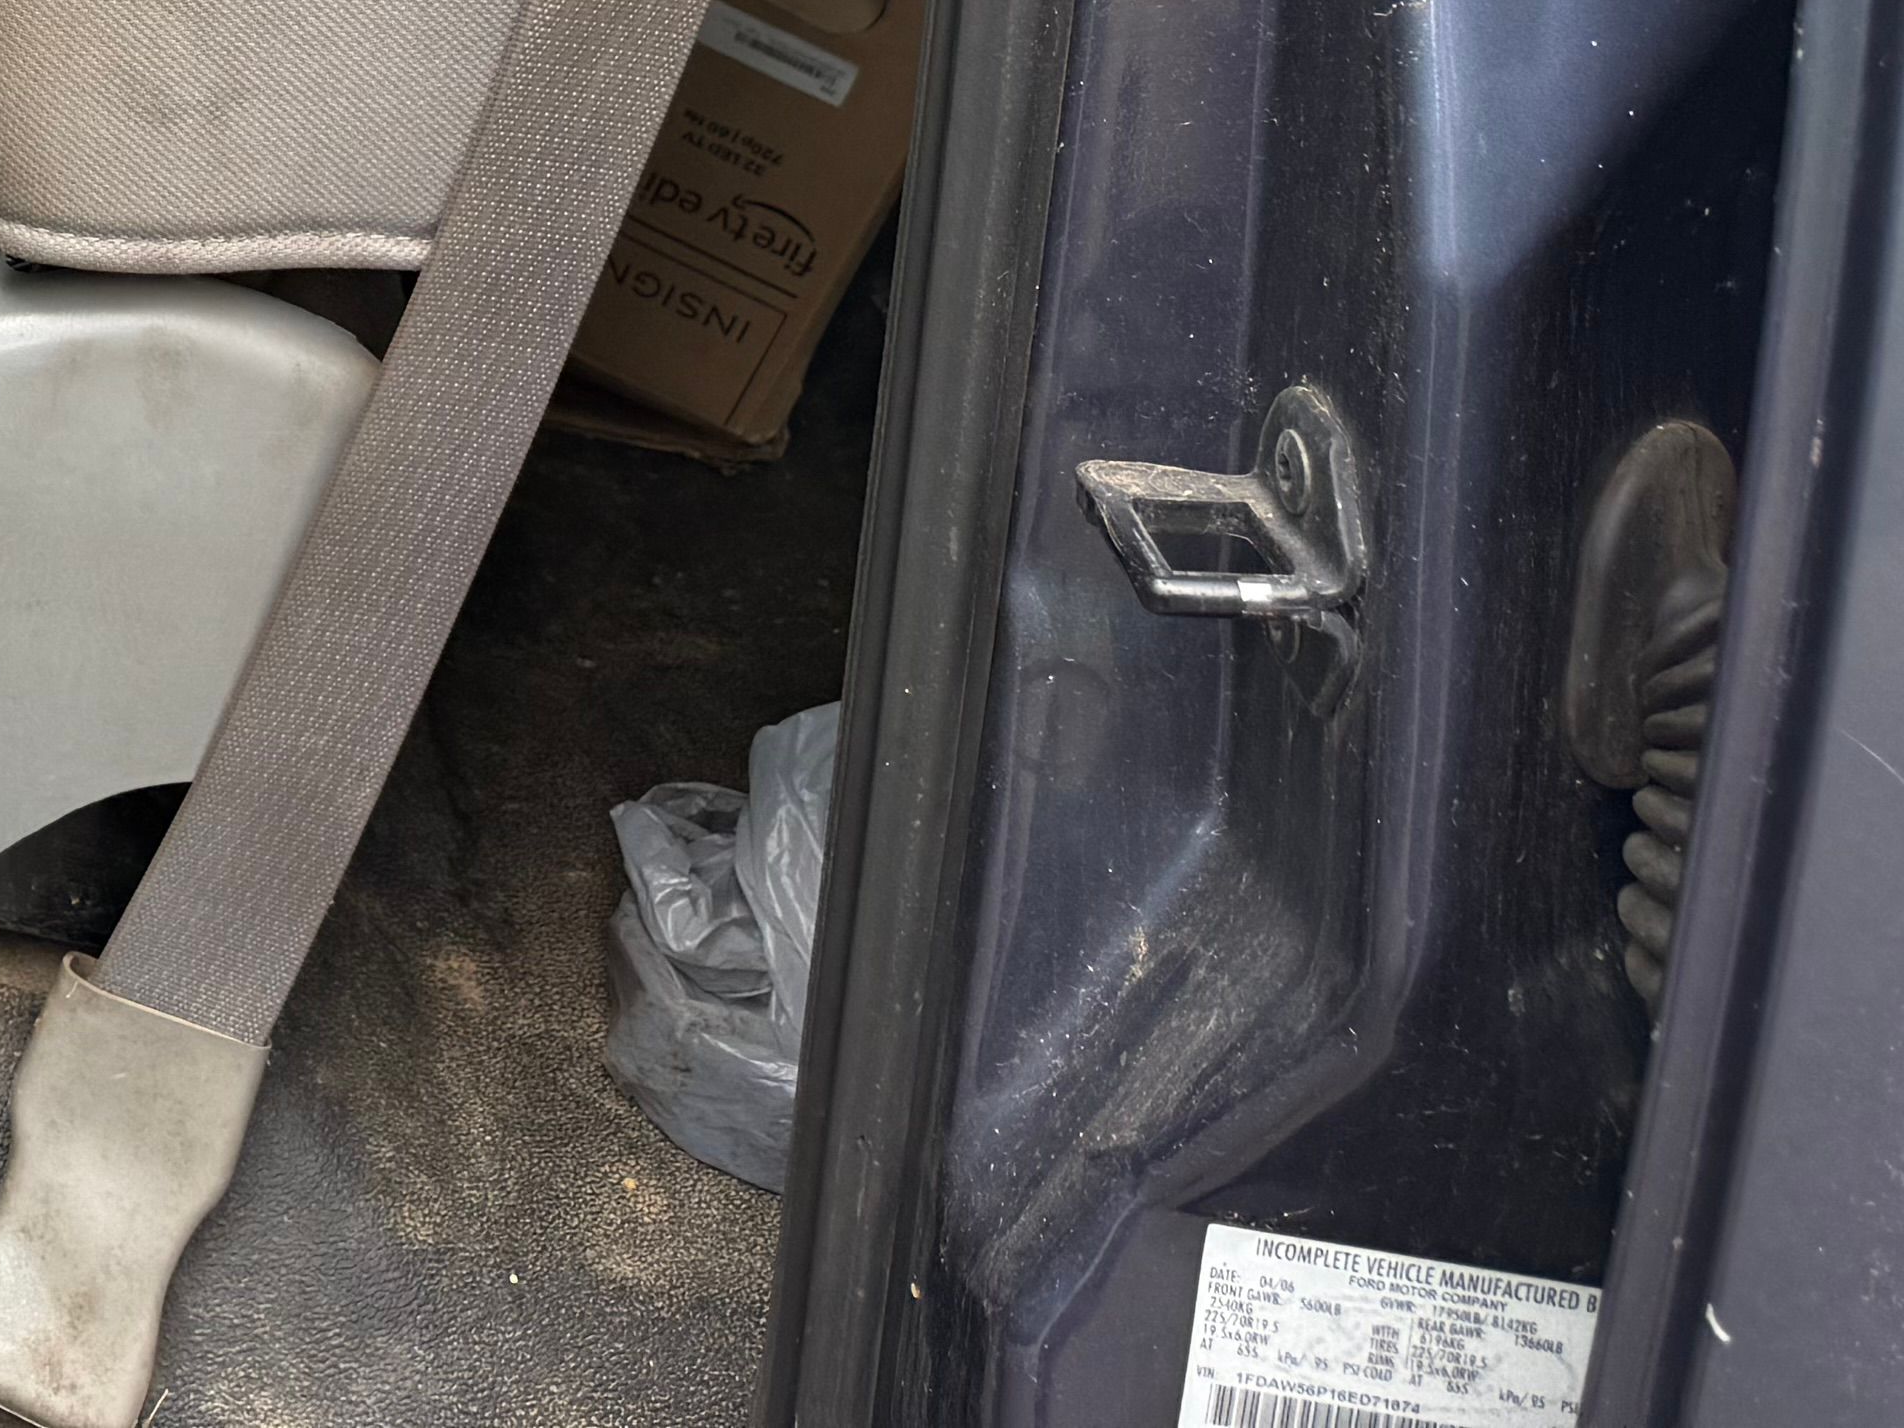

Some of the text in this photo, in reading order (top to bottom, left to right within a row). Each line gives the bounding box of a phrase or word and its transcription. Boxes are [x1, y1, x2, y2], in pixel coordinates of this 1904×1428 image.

[1210, 1266, 1295, 1294] DATE: 04/06
[1256, 1237, 1361, 1273] INCOMPLETE
[1367, 1256, 1435, 1286] VEHICLE
[1439, 1269, 1580, 1310] MANUFACTURED
[1207, 1281, 1243, 1298] FRONT
[1348, 1276, 1508, 1312] FORD MOTOR COMPANY
[1200, 1337, 1213, 1351] AT
[1409, 1374, 1423, 1387] AT
